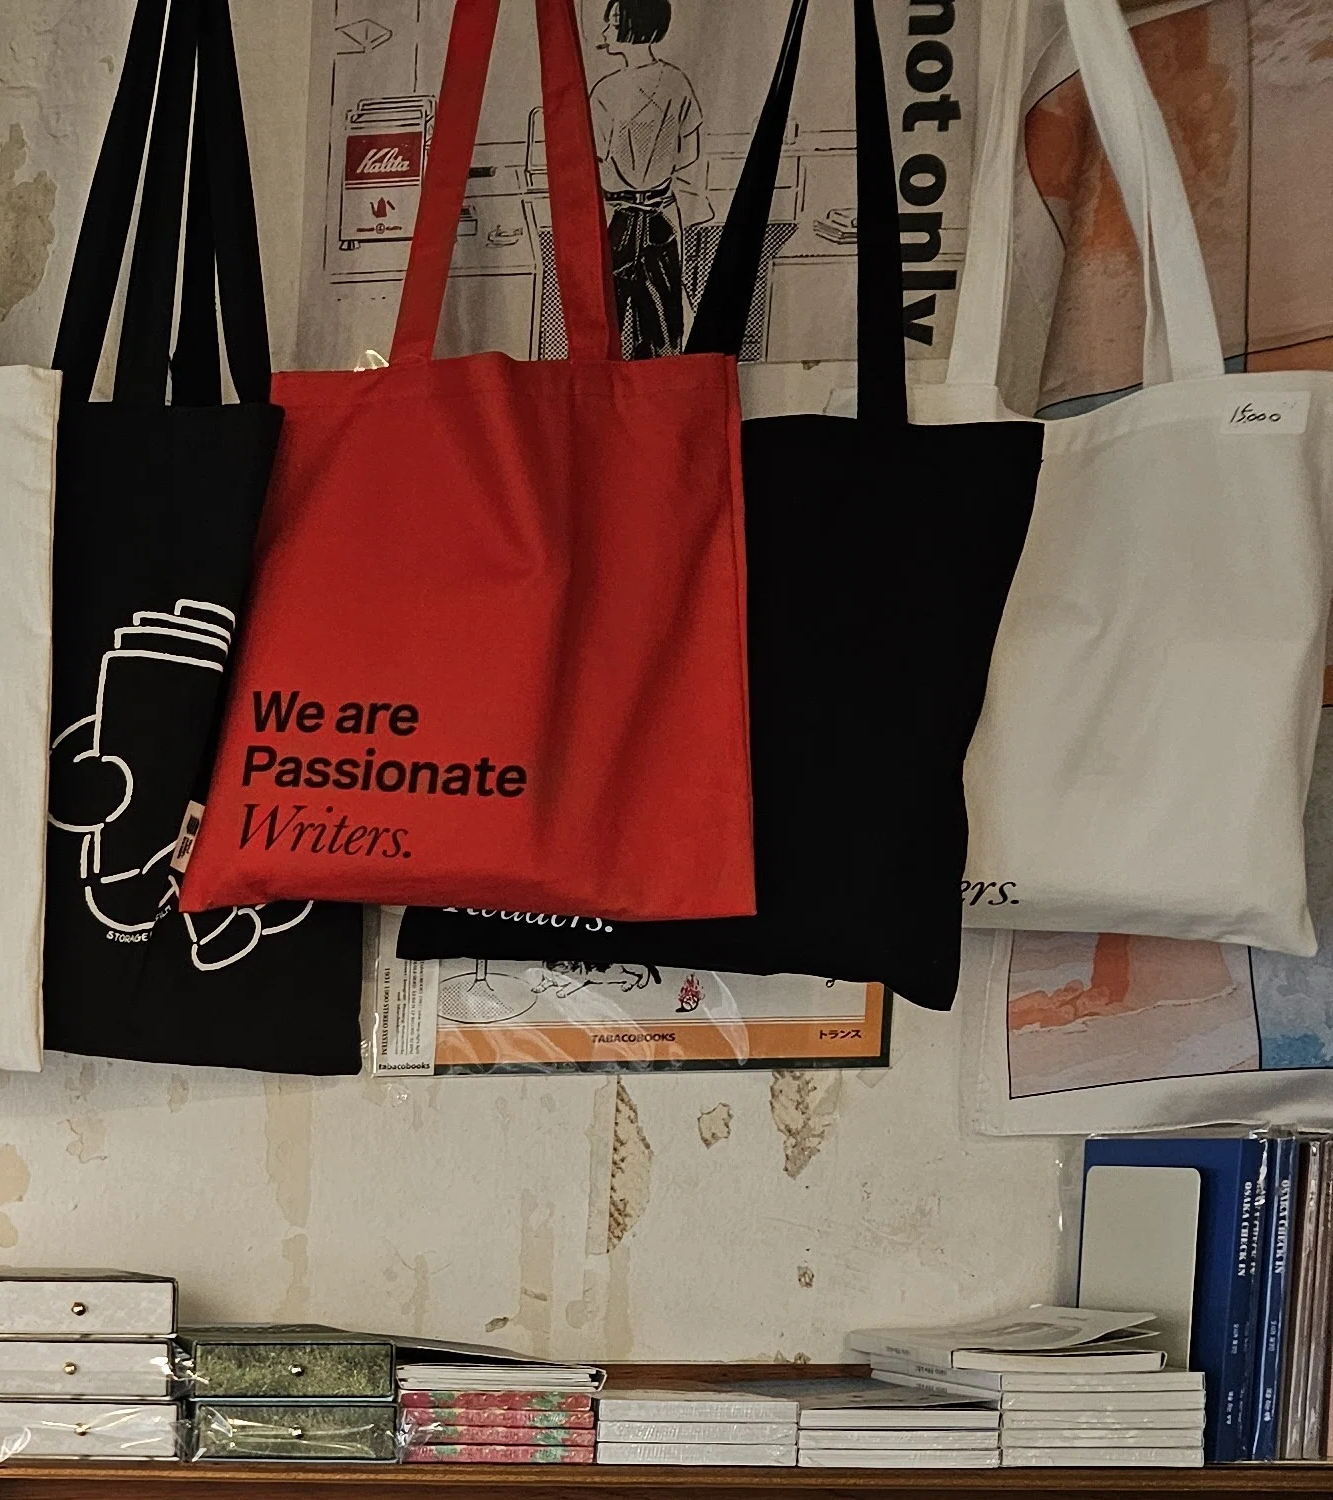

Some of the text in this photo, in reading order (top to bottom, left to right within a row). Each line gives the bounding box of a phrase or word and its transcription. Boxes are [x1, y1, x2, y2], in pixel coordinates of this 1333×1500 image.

[902, 0, 961, 133] not
[358, 147, 411, 177] Kalita
[252, 690, 419, 736] We are
[241, 745, 528, 797] Passionate
[238, 802, 412, 860] Writers.
[106, 930, 149, 944] STORAGE
[591, 1032, 676, 1044] TABACOBOOKS
[818, 1029, 862, 1040] トランス
[379, 1062, 430, 1071] tabacobooks
[1238, 1182, 1252, 1276] OSAKA CHECK IN
